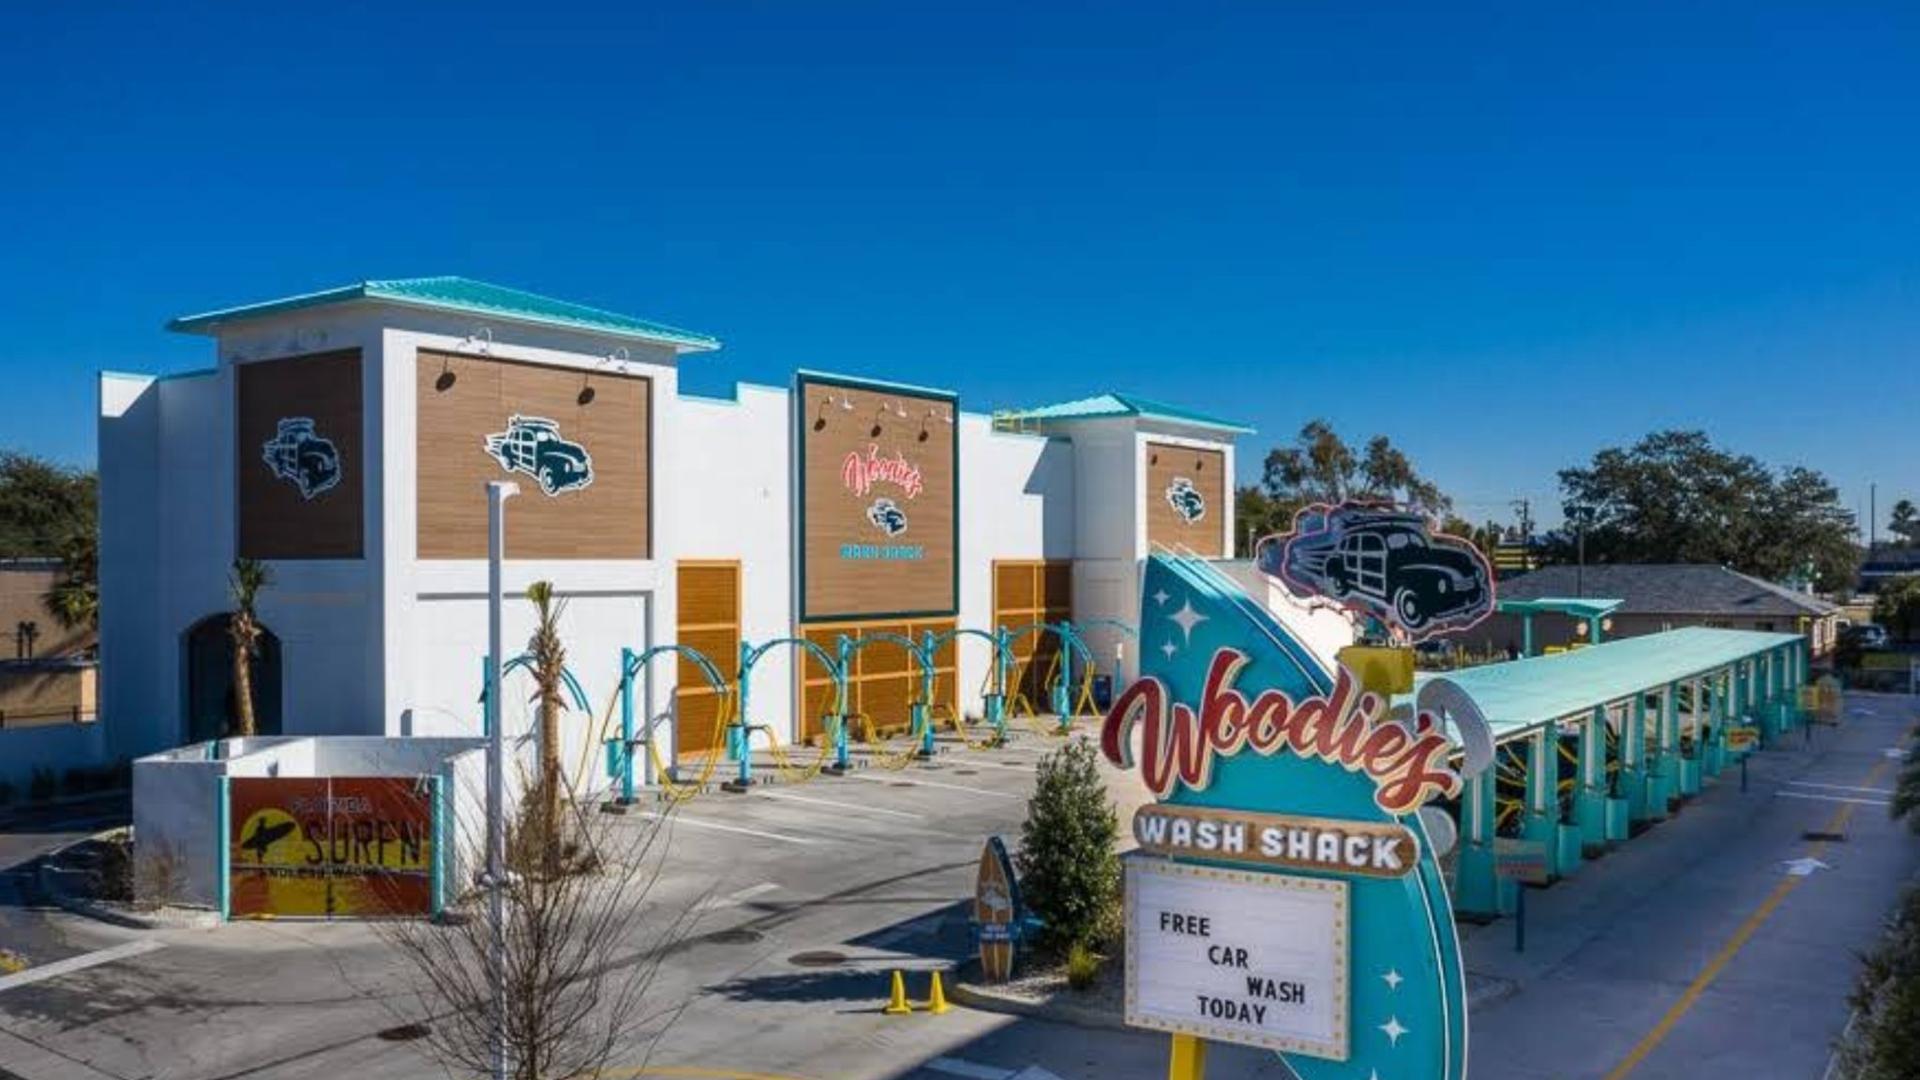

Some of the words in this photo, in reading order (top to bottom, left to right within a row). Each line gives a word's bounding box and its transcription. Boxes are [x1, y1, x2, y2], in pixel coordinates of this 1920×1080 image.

[1100, 646, 1464, 814] Woodie's
[1139, 816, 1244, 853] WASH
[1261, 828, 1402, 870] SHACK
[1160, 912, 1210, 937] FREE
[1208, 946, 1249, 969] CAR
[1247, 977, 1305, 1004] WASH
[1197, 996, 1266, 1024] TODAY
